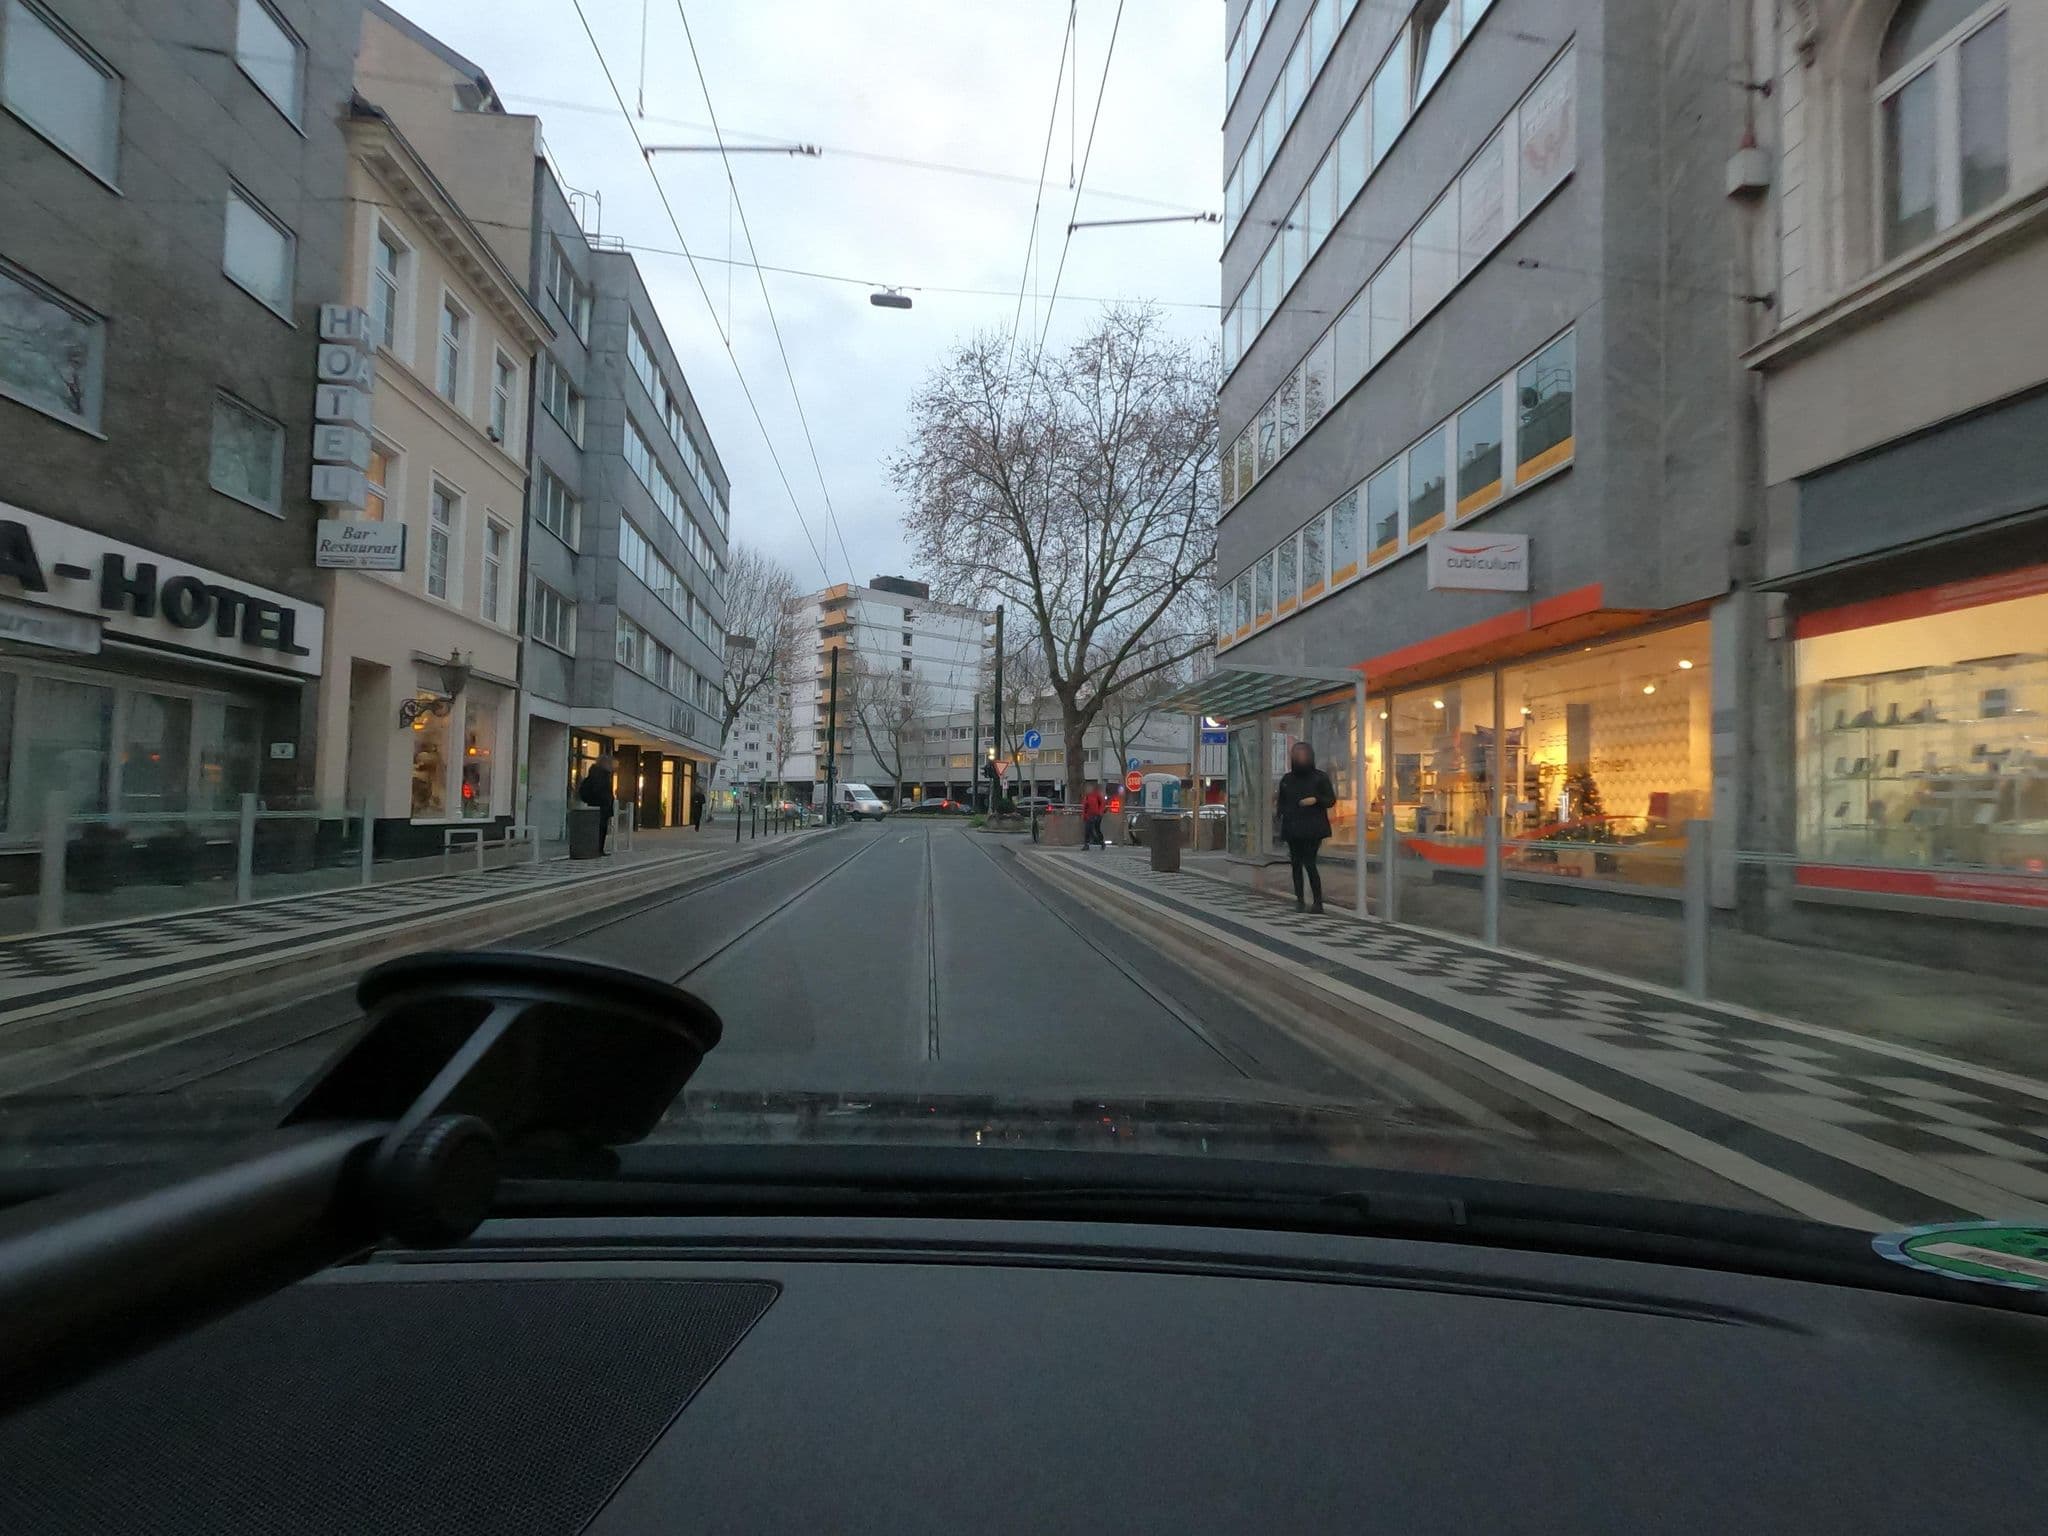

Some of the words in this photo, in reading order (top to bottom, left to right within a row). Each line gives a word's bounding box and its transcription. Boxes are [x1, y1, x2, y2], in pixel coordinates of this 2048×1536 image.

[323, 308, 350, 497] HOTEL
[319, 539, 398, 554] Restaurant
[1447, 555, 1521, 571] cubiculum
